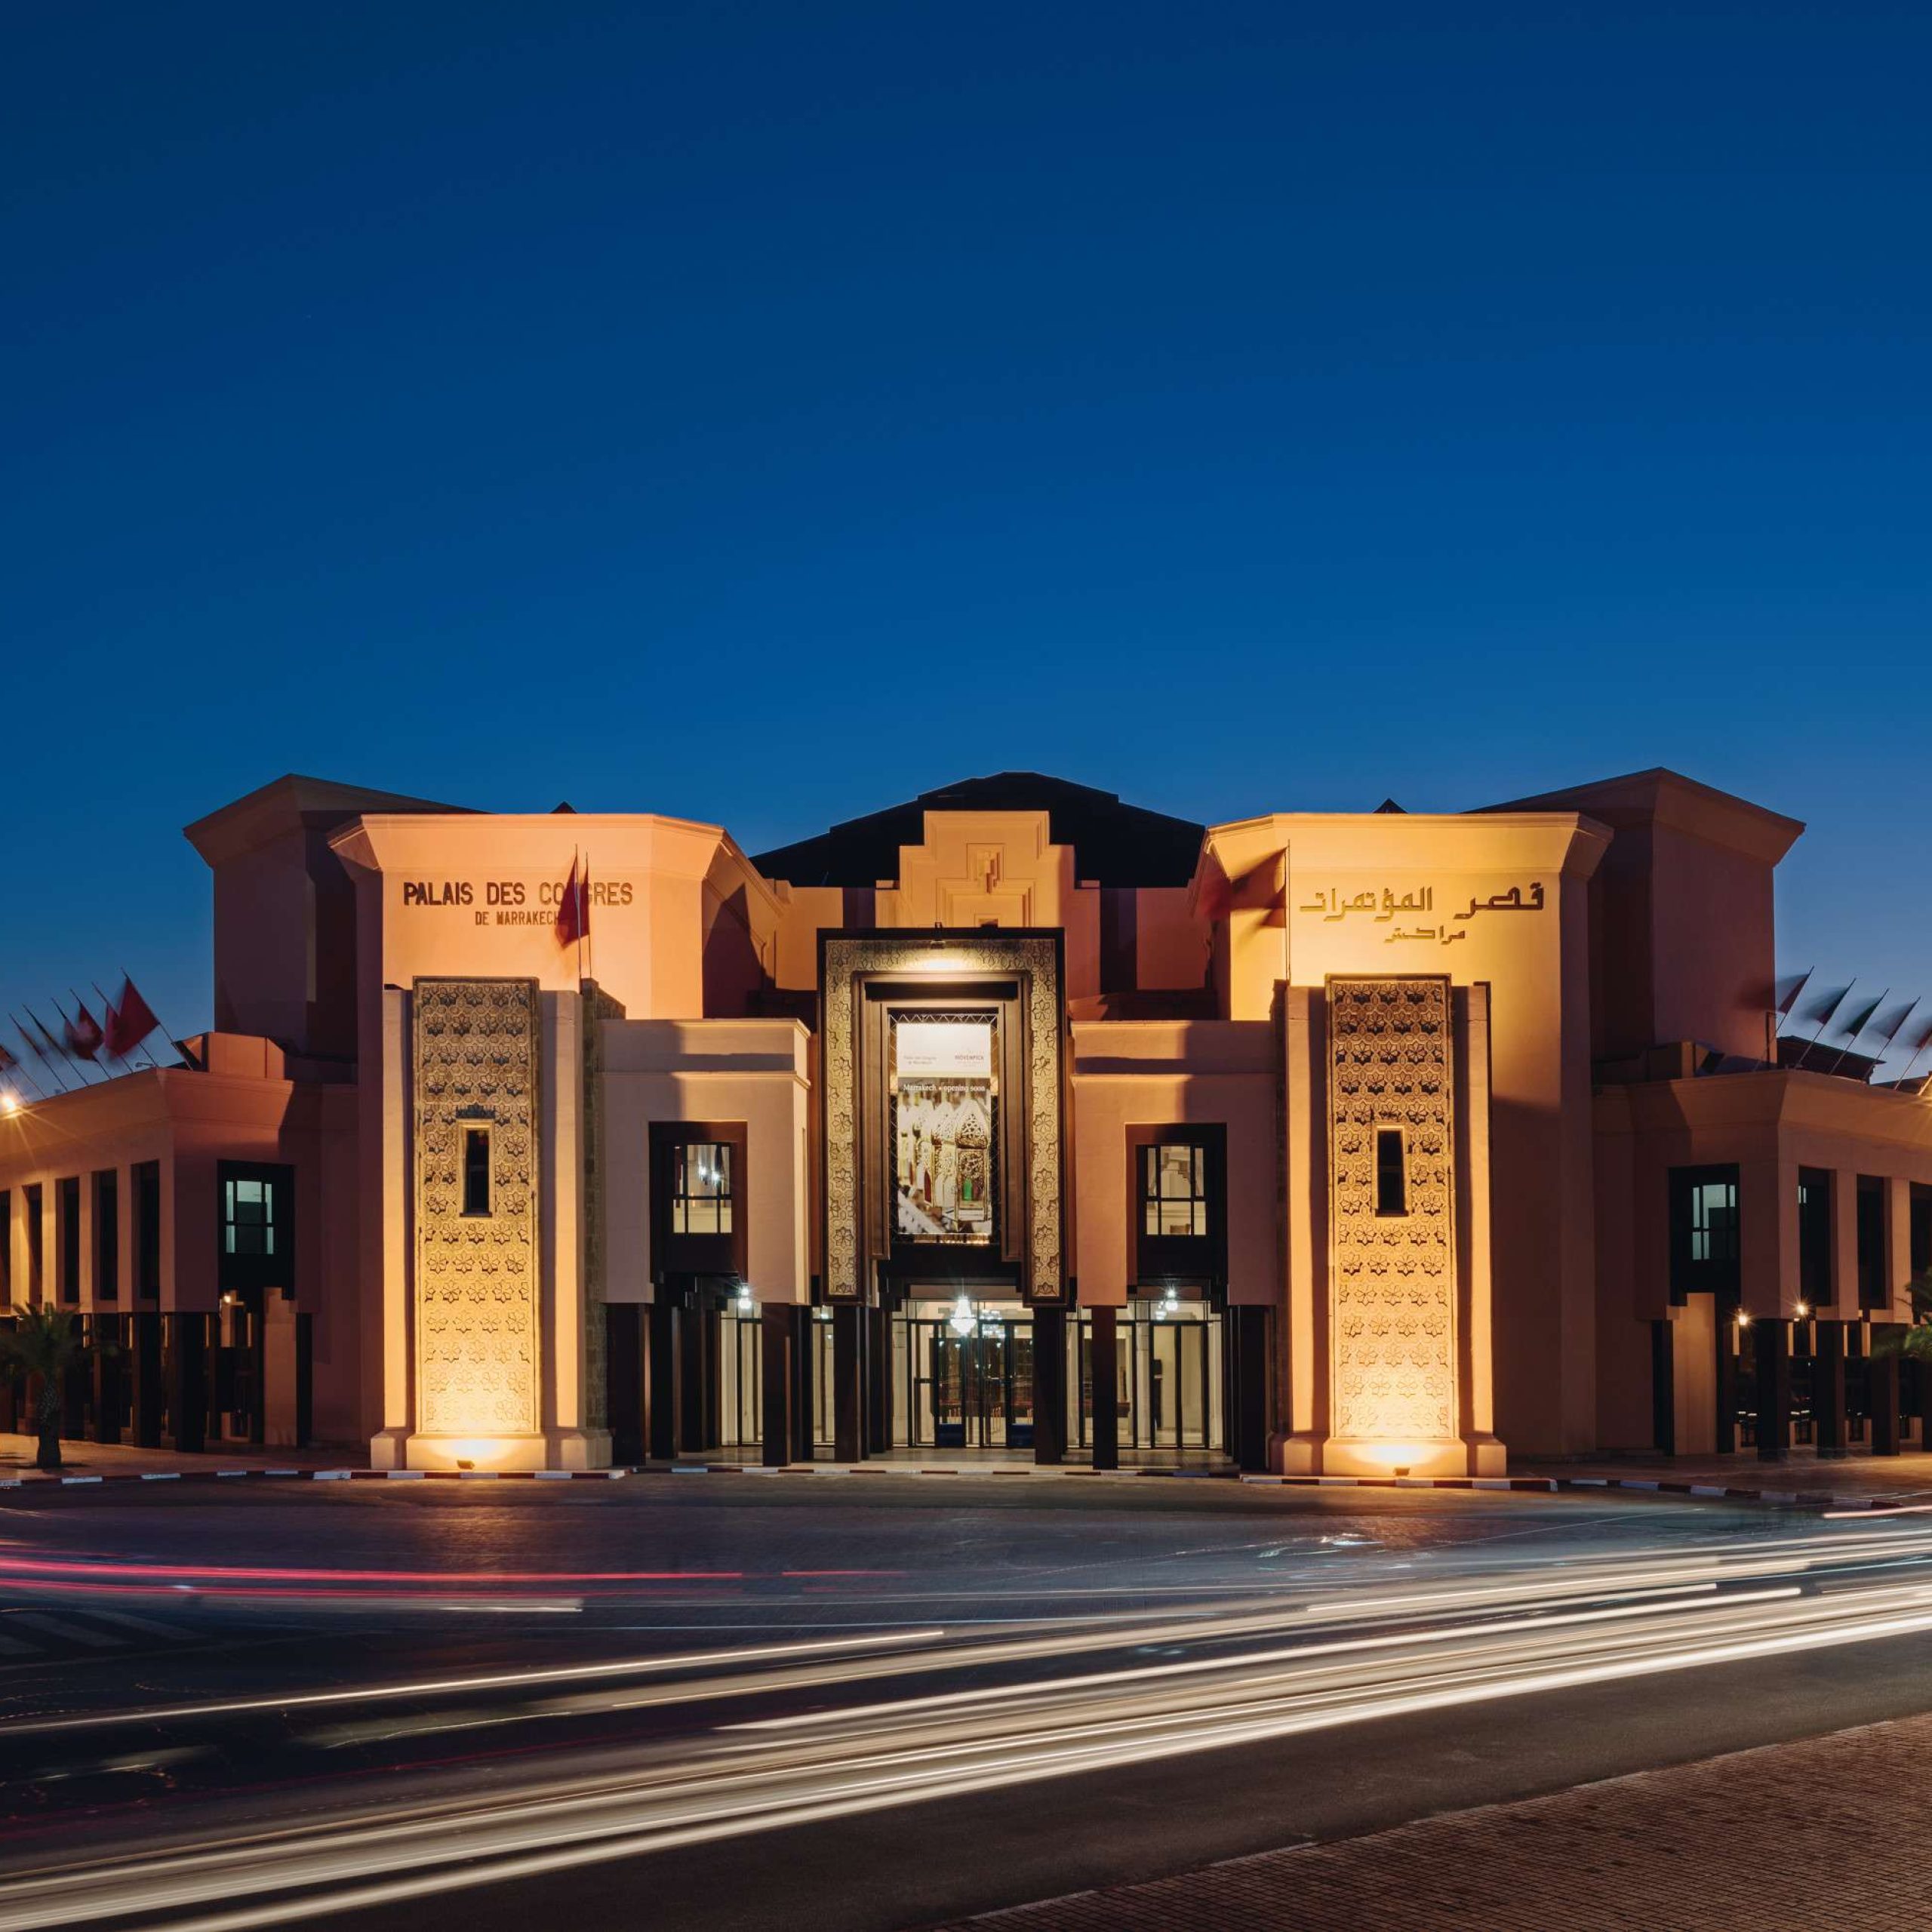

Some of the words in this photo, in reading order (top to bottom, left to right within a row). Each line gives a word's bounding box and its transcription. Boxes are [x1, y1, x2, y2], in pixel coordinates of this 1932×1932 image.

[403, 881, 473, 906] PALAIS
[486, 881, 525, 906] DES
[538, 881, 633, 906] CORES
[1299, 886, 1433, 922] المؤتمرات
[1453, 881, 1545, 920] قصر
[475, 911, 489, 925] DE
[1383, 924, 1466, 946] مراكش
